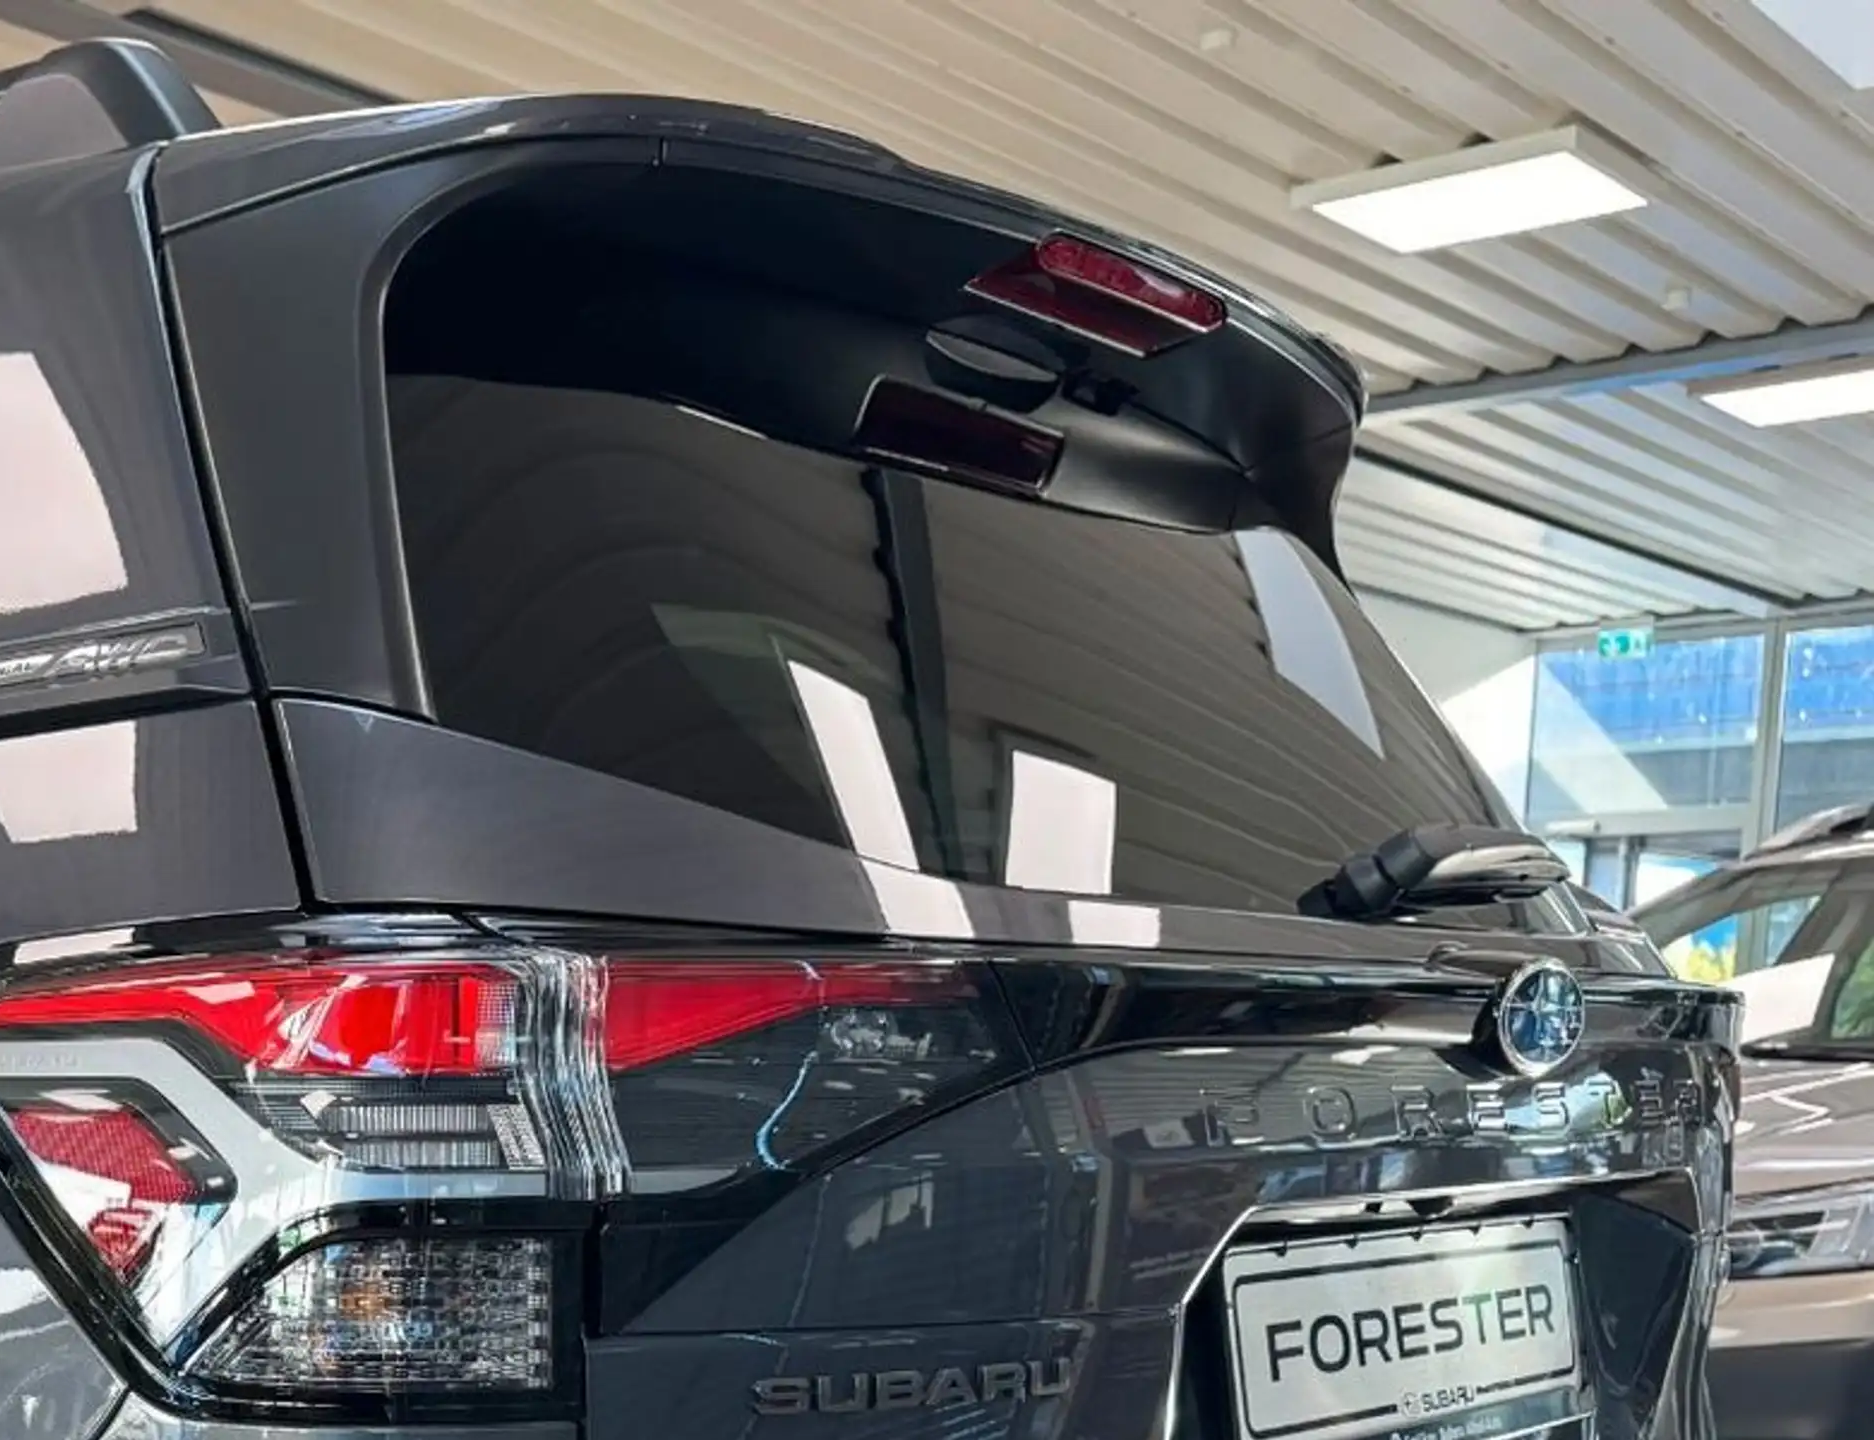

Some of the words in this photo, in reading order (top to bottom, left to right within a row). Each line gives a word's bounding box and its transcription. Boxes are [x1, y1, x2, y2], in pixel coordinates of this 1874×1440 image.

[1200, 1066, 1703, 1146] FORESTER
[1266, 1284, 1556, 1382] FORESTER
[751, 1357, 1070, 1416] SUBARU
[1421, 1384, 1474, 1412] SUBARU
